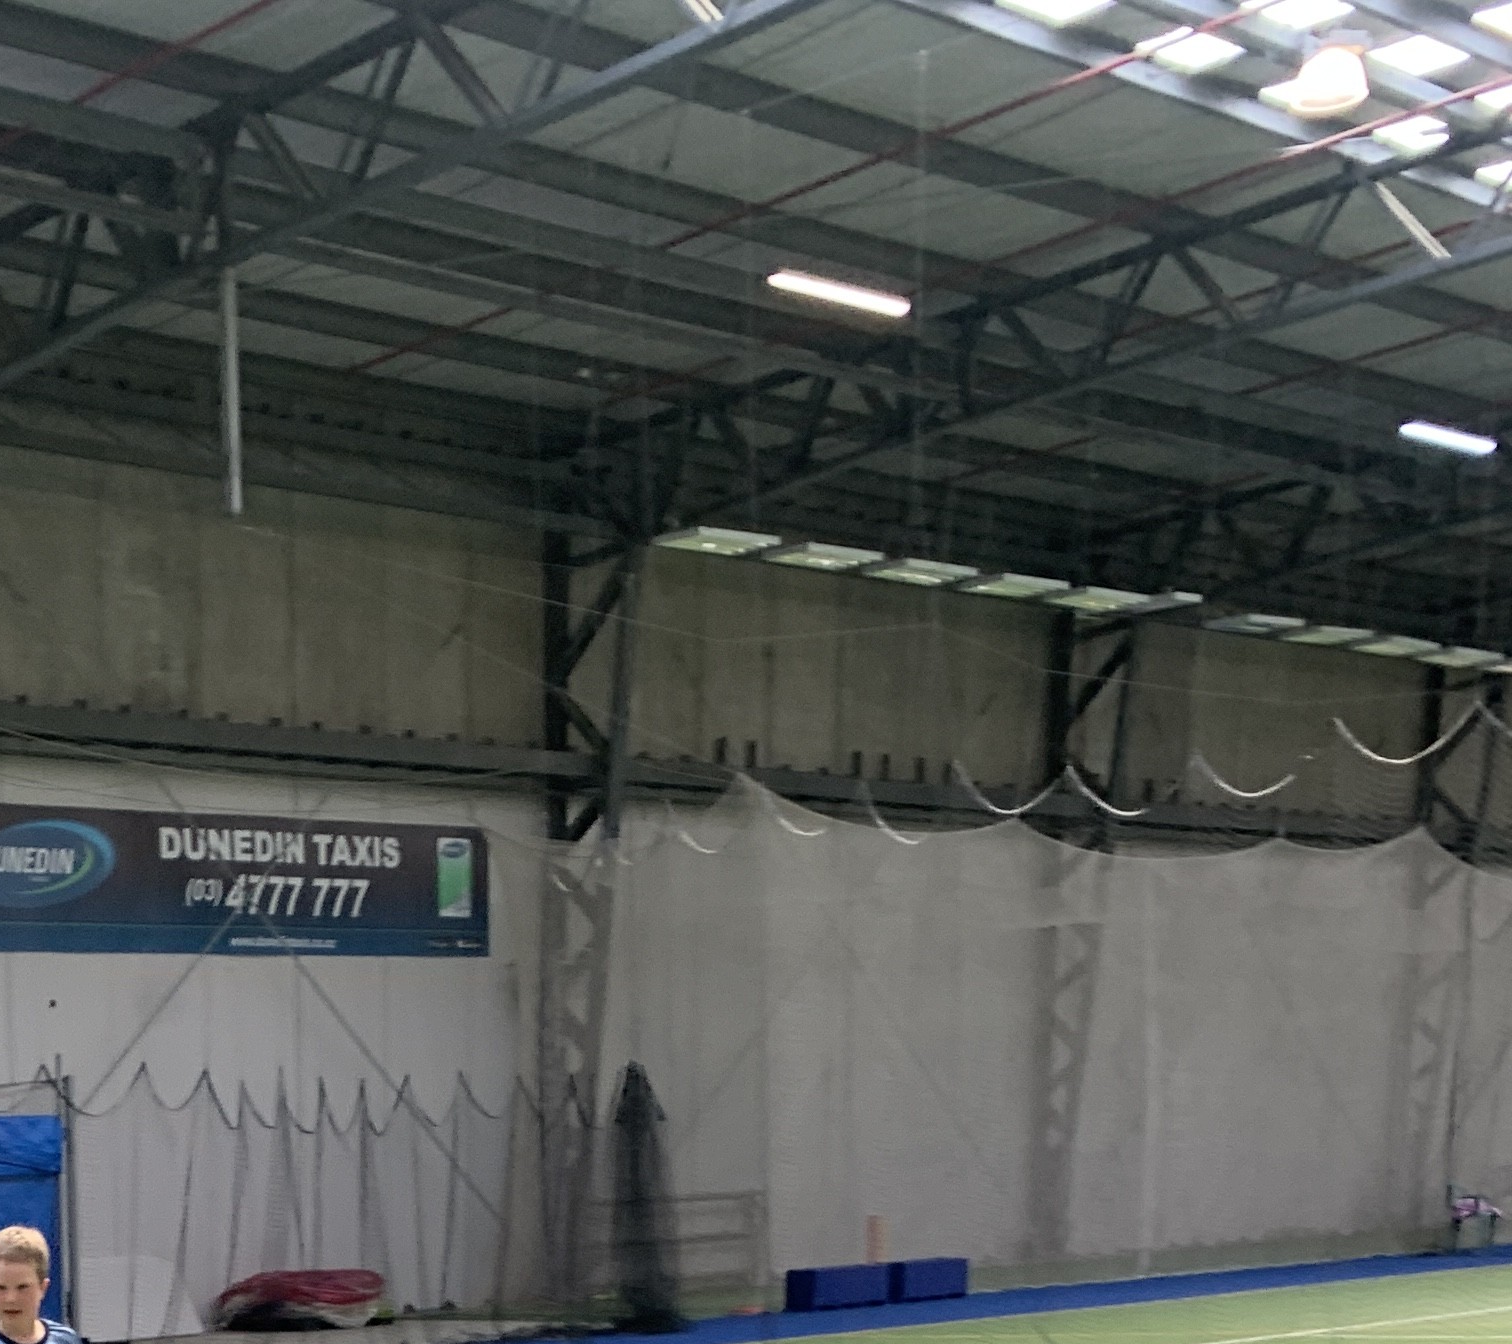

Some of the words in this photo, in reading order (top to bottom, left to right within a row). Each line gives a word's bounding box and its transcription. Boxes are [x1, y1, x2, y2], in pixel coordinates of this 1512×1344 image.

[159, 826, 305, 864] DUNEDIN
[311, 834, 402, 868] TAXIS
[311, 877, 370, 918] 777
